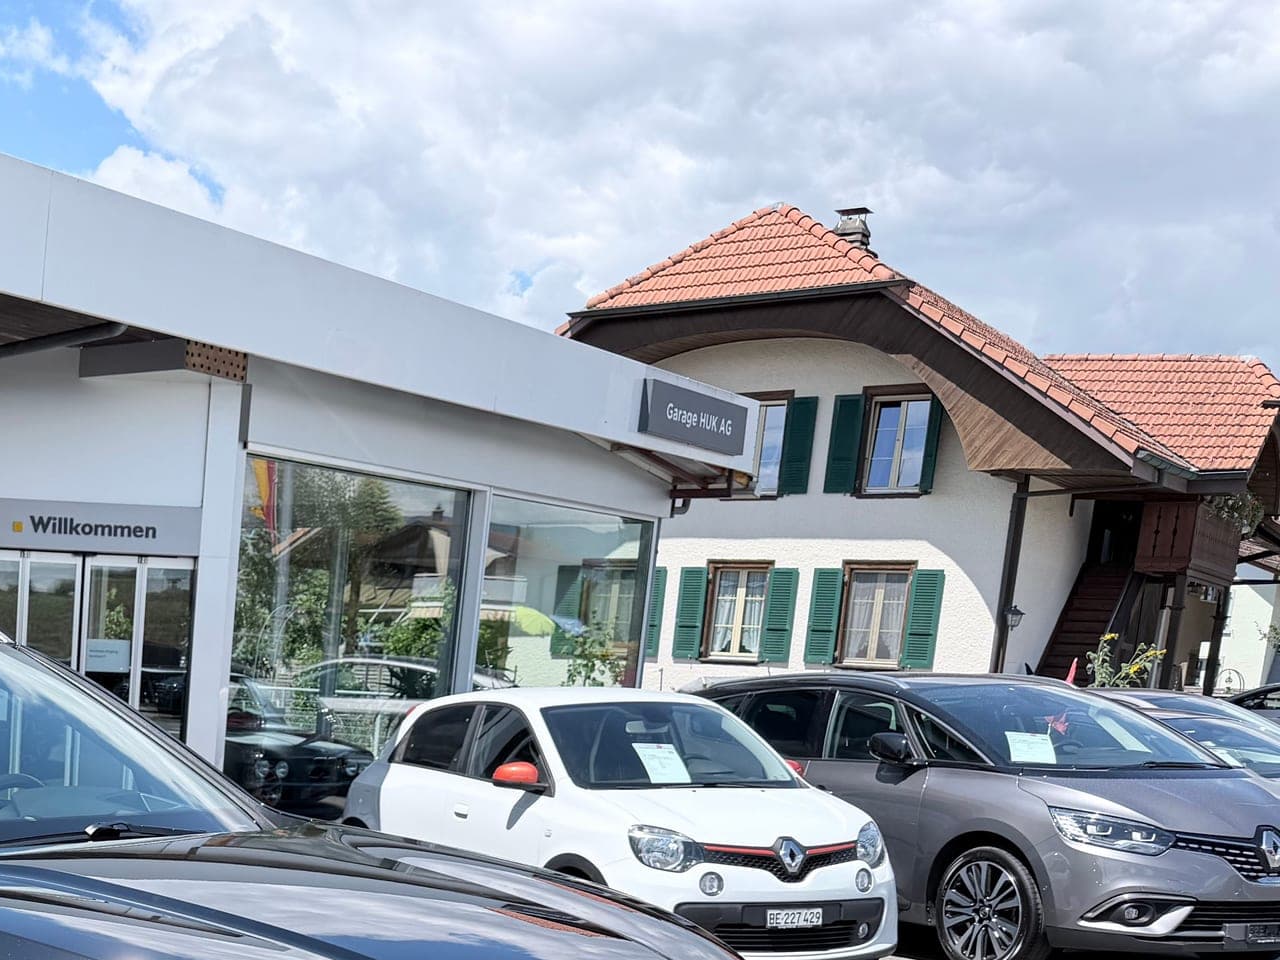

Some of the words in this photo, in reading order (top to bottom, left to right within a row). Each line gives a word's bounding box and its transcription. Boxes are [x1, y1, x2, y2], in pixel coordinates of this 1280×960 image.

[666, 402, 698, 428] Garage
[699, 411, 719, 432] HUK
[719, 417, 733, 436] AG
[29, 514, 157, 539] Willkommen
